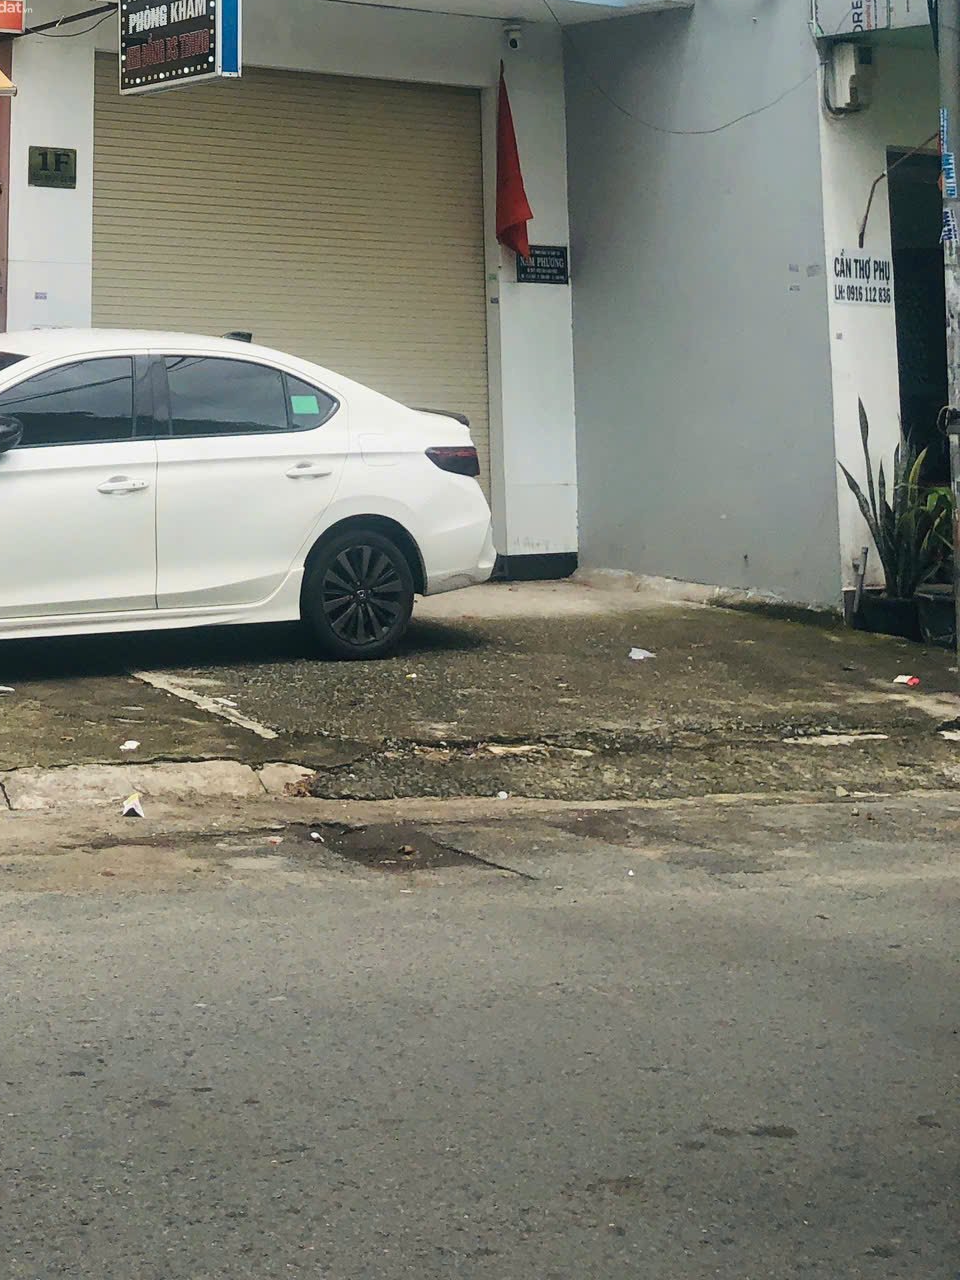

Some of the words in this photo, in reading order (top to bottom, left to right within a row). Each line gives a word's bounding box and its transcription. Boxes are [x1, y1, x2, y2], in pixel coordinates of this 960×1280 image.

[128, 4, 168, 35] PHÒNG
[846, 285, 863, 302] 0916
[865, 286, 877, 303] 112
